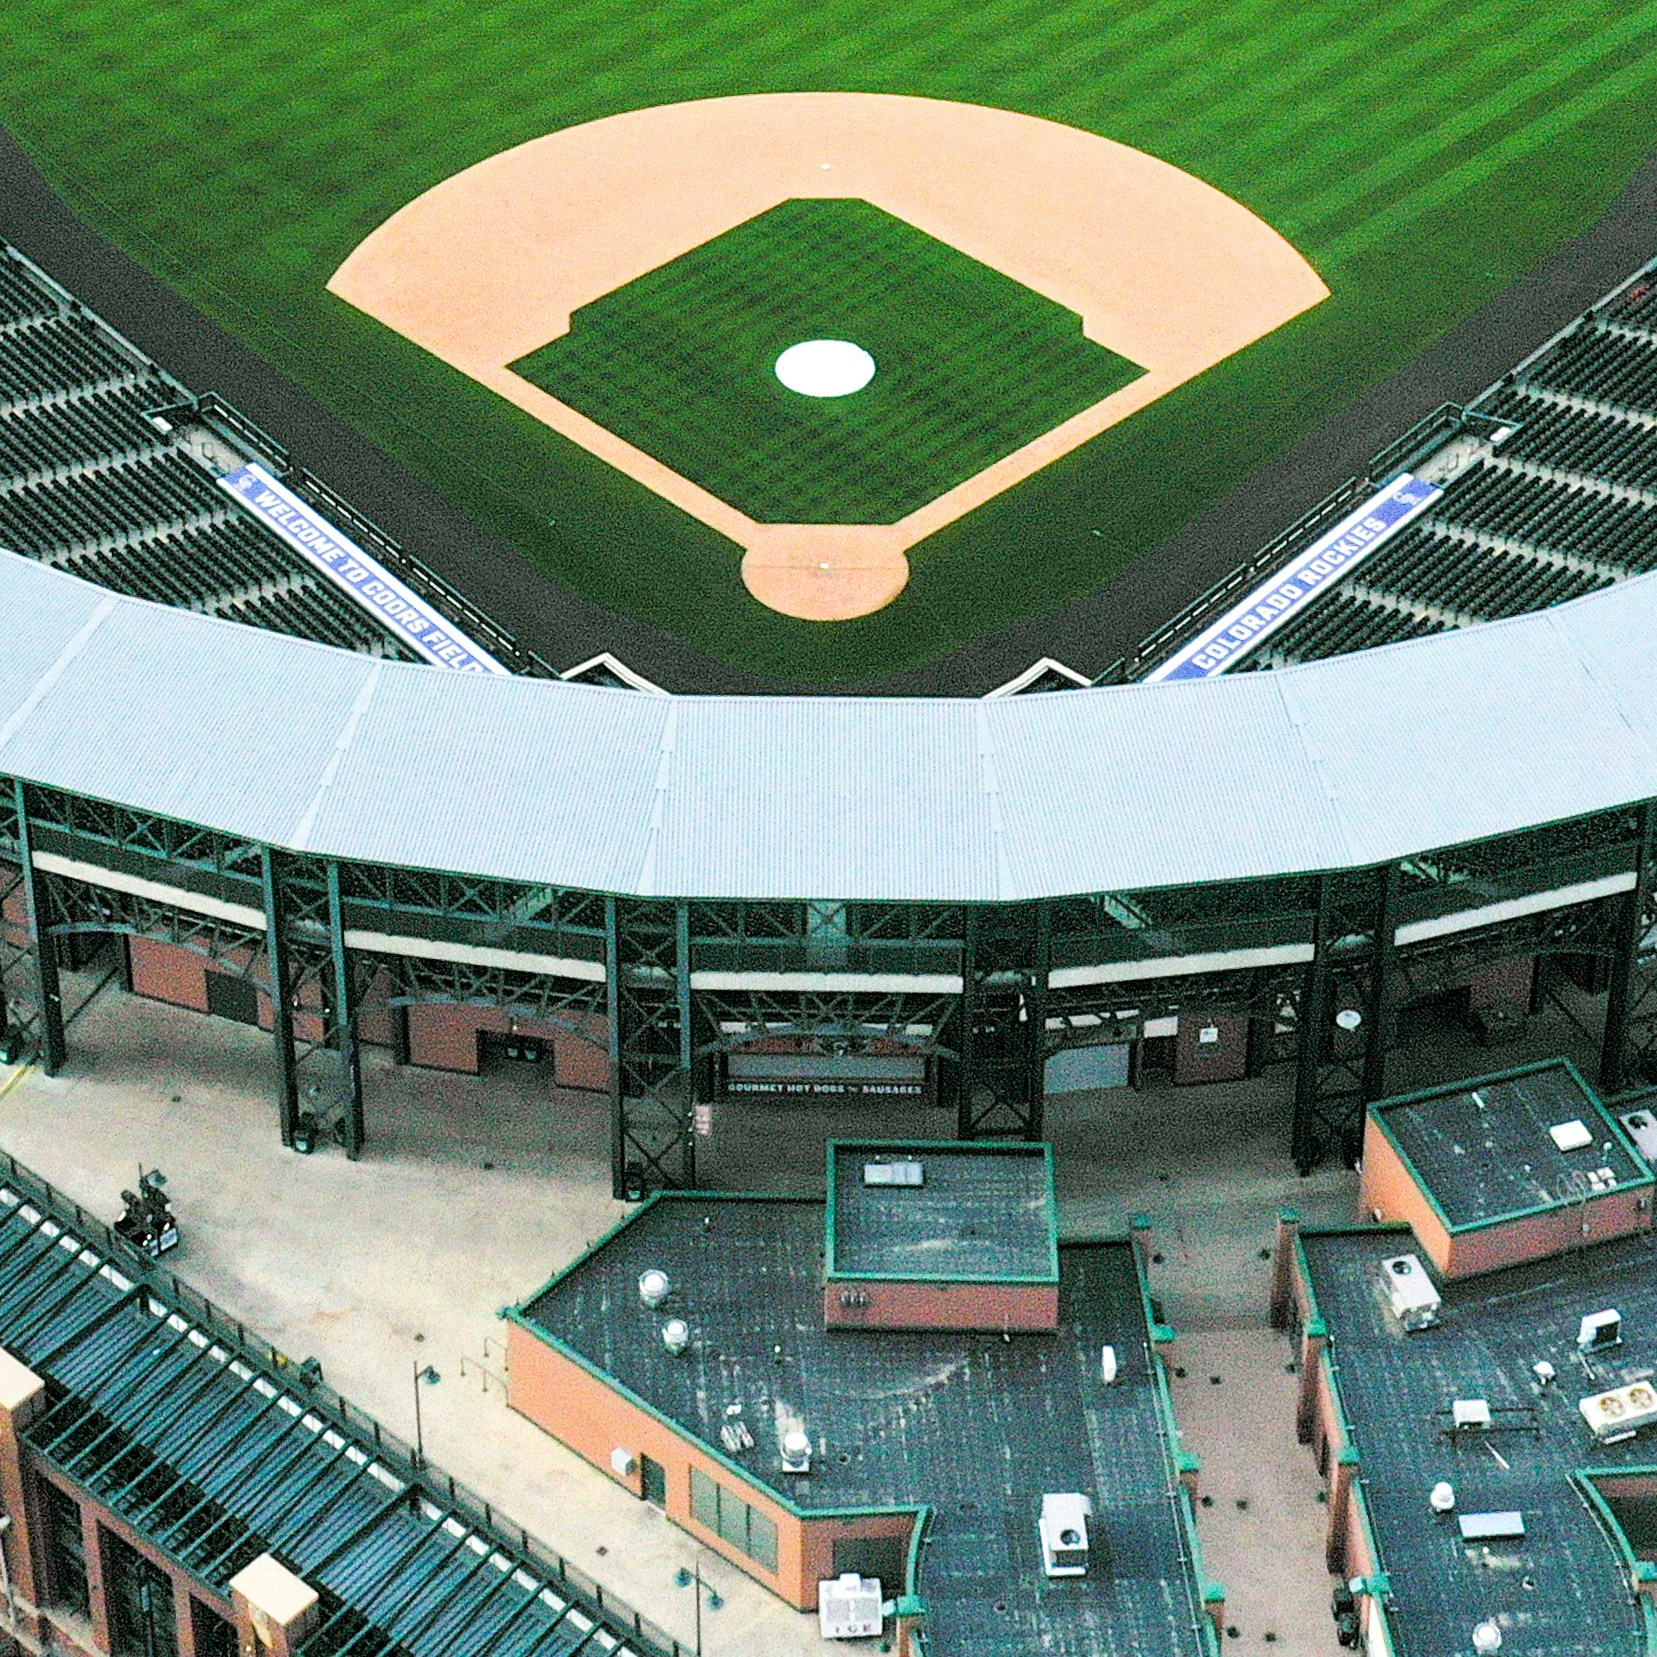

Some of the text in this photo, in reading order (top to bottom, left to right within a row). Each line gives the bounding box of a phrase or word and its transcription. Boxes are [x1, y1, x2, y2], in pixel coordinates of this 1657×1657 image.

[253, 489, 489, 676] WELCOME TO COORS FIELD
[1191, 516, 1387, 670] COLORADO ROCKIES
